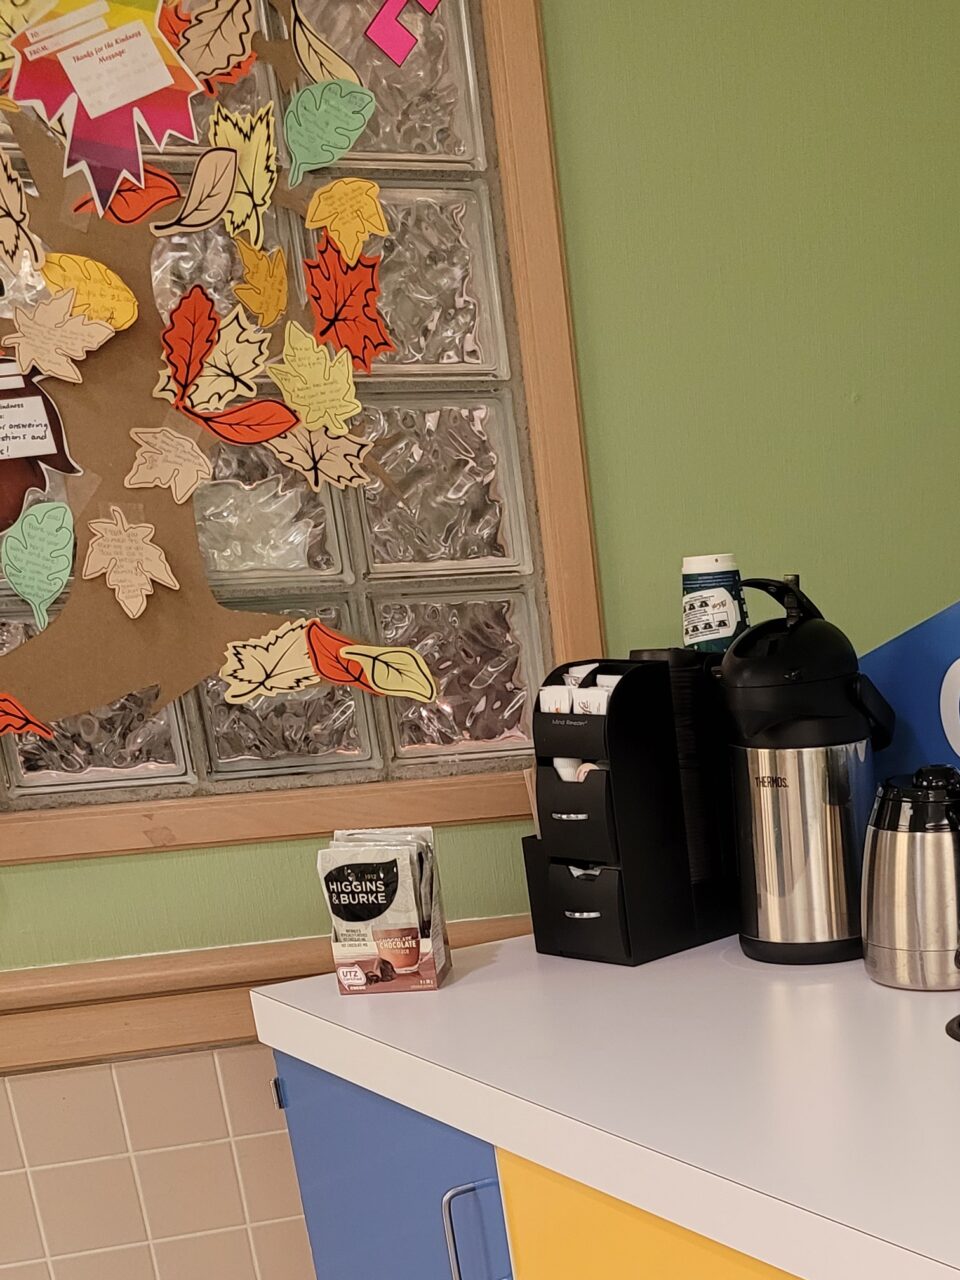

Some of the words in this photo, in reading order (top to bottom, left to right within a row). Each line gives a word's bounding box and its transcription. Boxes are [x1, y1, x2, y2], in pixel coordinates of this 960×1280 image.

[115, 30, 142, 46] Kindness
[0, 431, 27, 442] stions
[31, 430, 47, 440] and
[329, 880, 385, 892] HIGGINS
[379, 940, 417, 949] CHOCOLATE
[342, 970, 359, 978] UTZ
